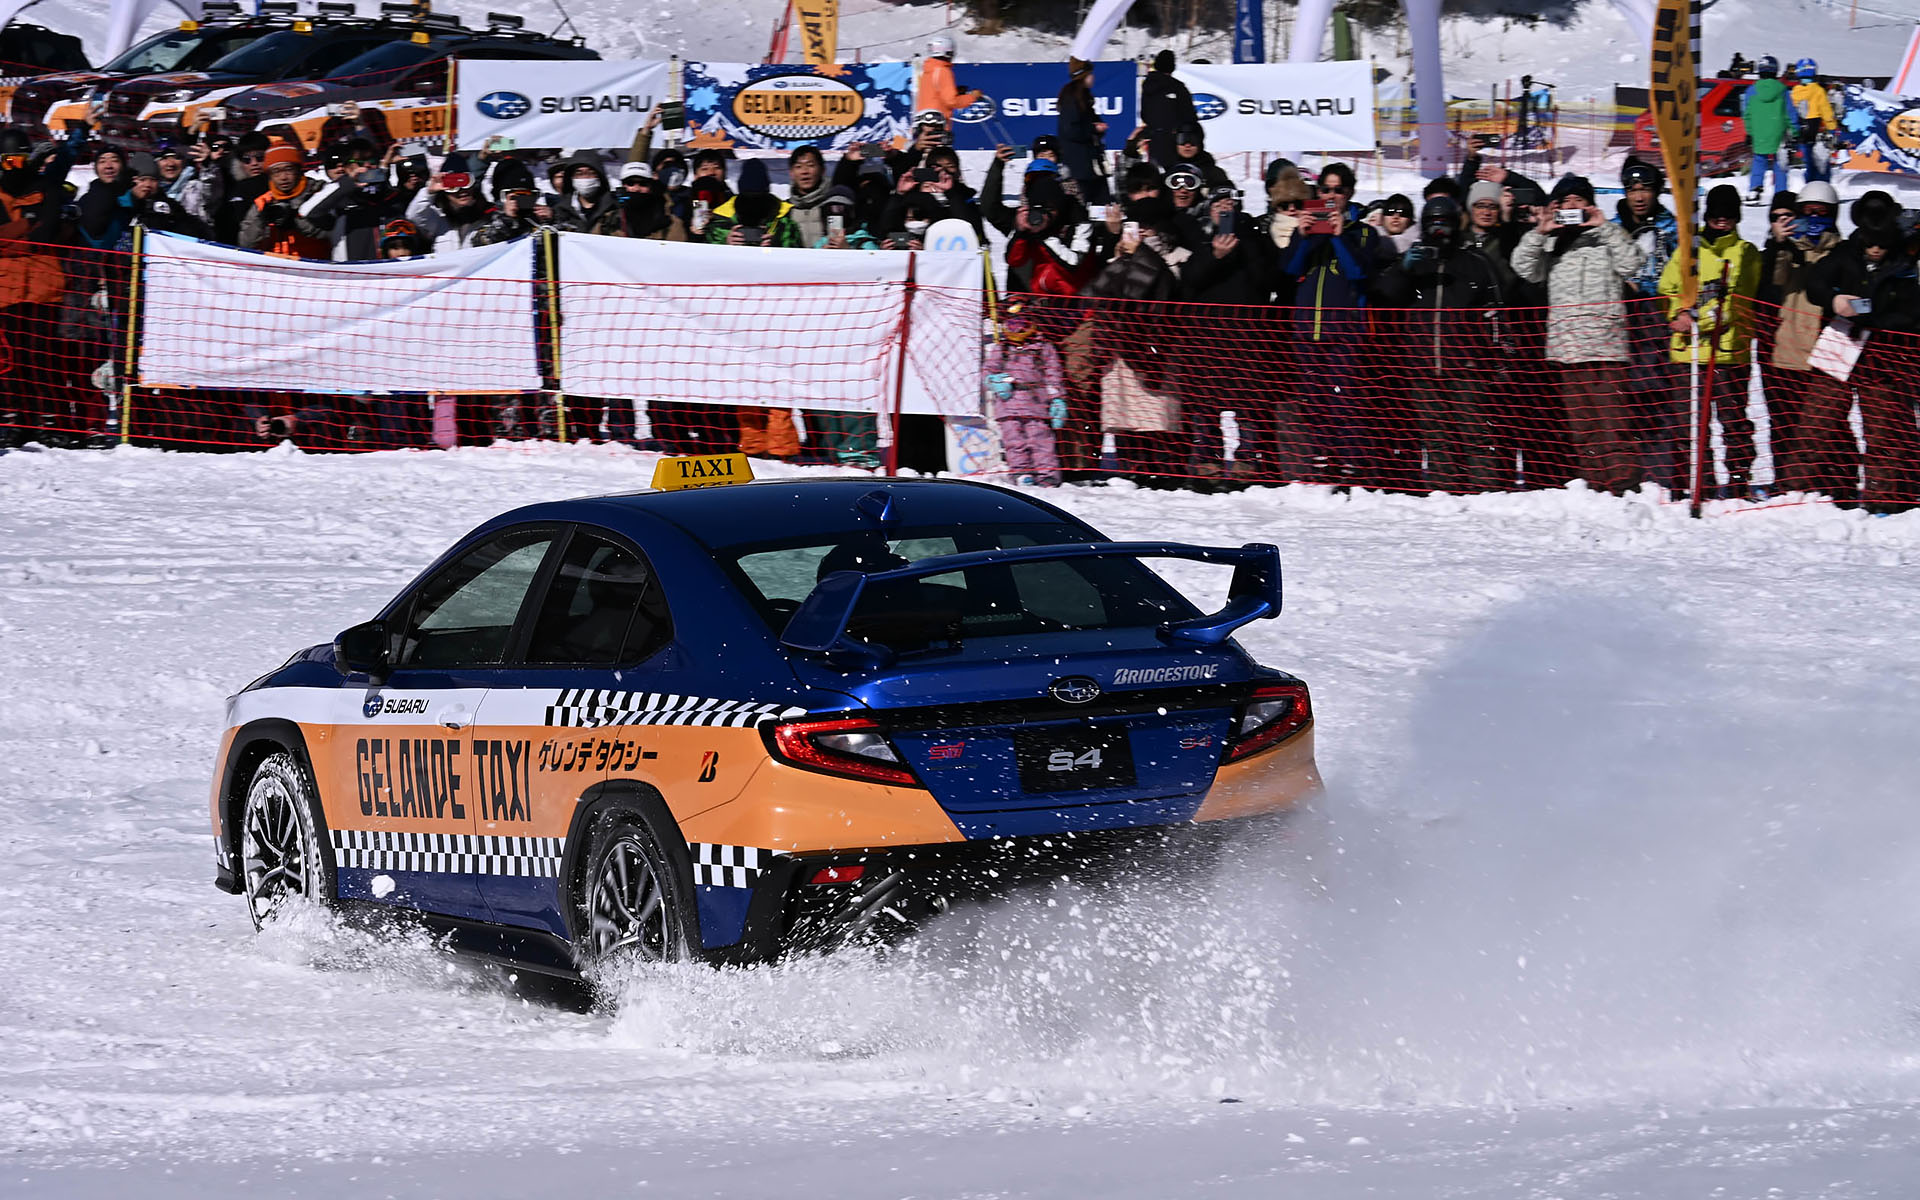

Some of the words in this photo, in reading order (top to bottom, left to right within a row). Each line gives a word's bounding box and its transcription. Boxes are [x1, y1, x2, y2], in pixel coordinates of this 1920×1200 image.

[540, 95, 652, 114] SUBARU
[743, 94, 813, 114] GELANDE
[820, 94, 854, 114] TAXI
[1238, 98, 1354, 117] SUBARU
[677, 458, 734, 478] TAXI
[1113, 663, 1219, 685] BRIDGESTONE
[384, 699, 430, 714] SUBARU
[538, 737, 658, 772] ゲレンデタクシー
[1047, 749, 1103, 771] S4
[356, 738, 466, 820] GELANDE
[473, 740, 531, 822] TAXI
